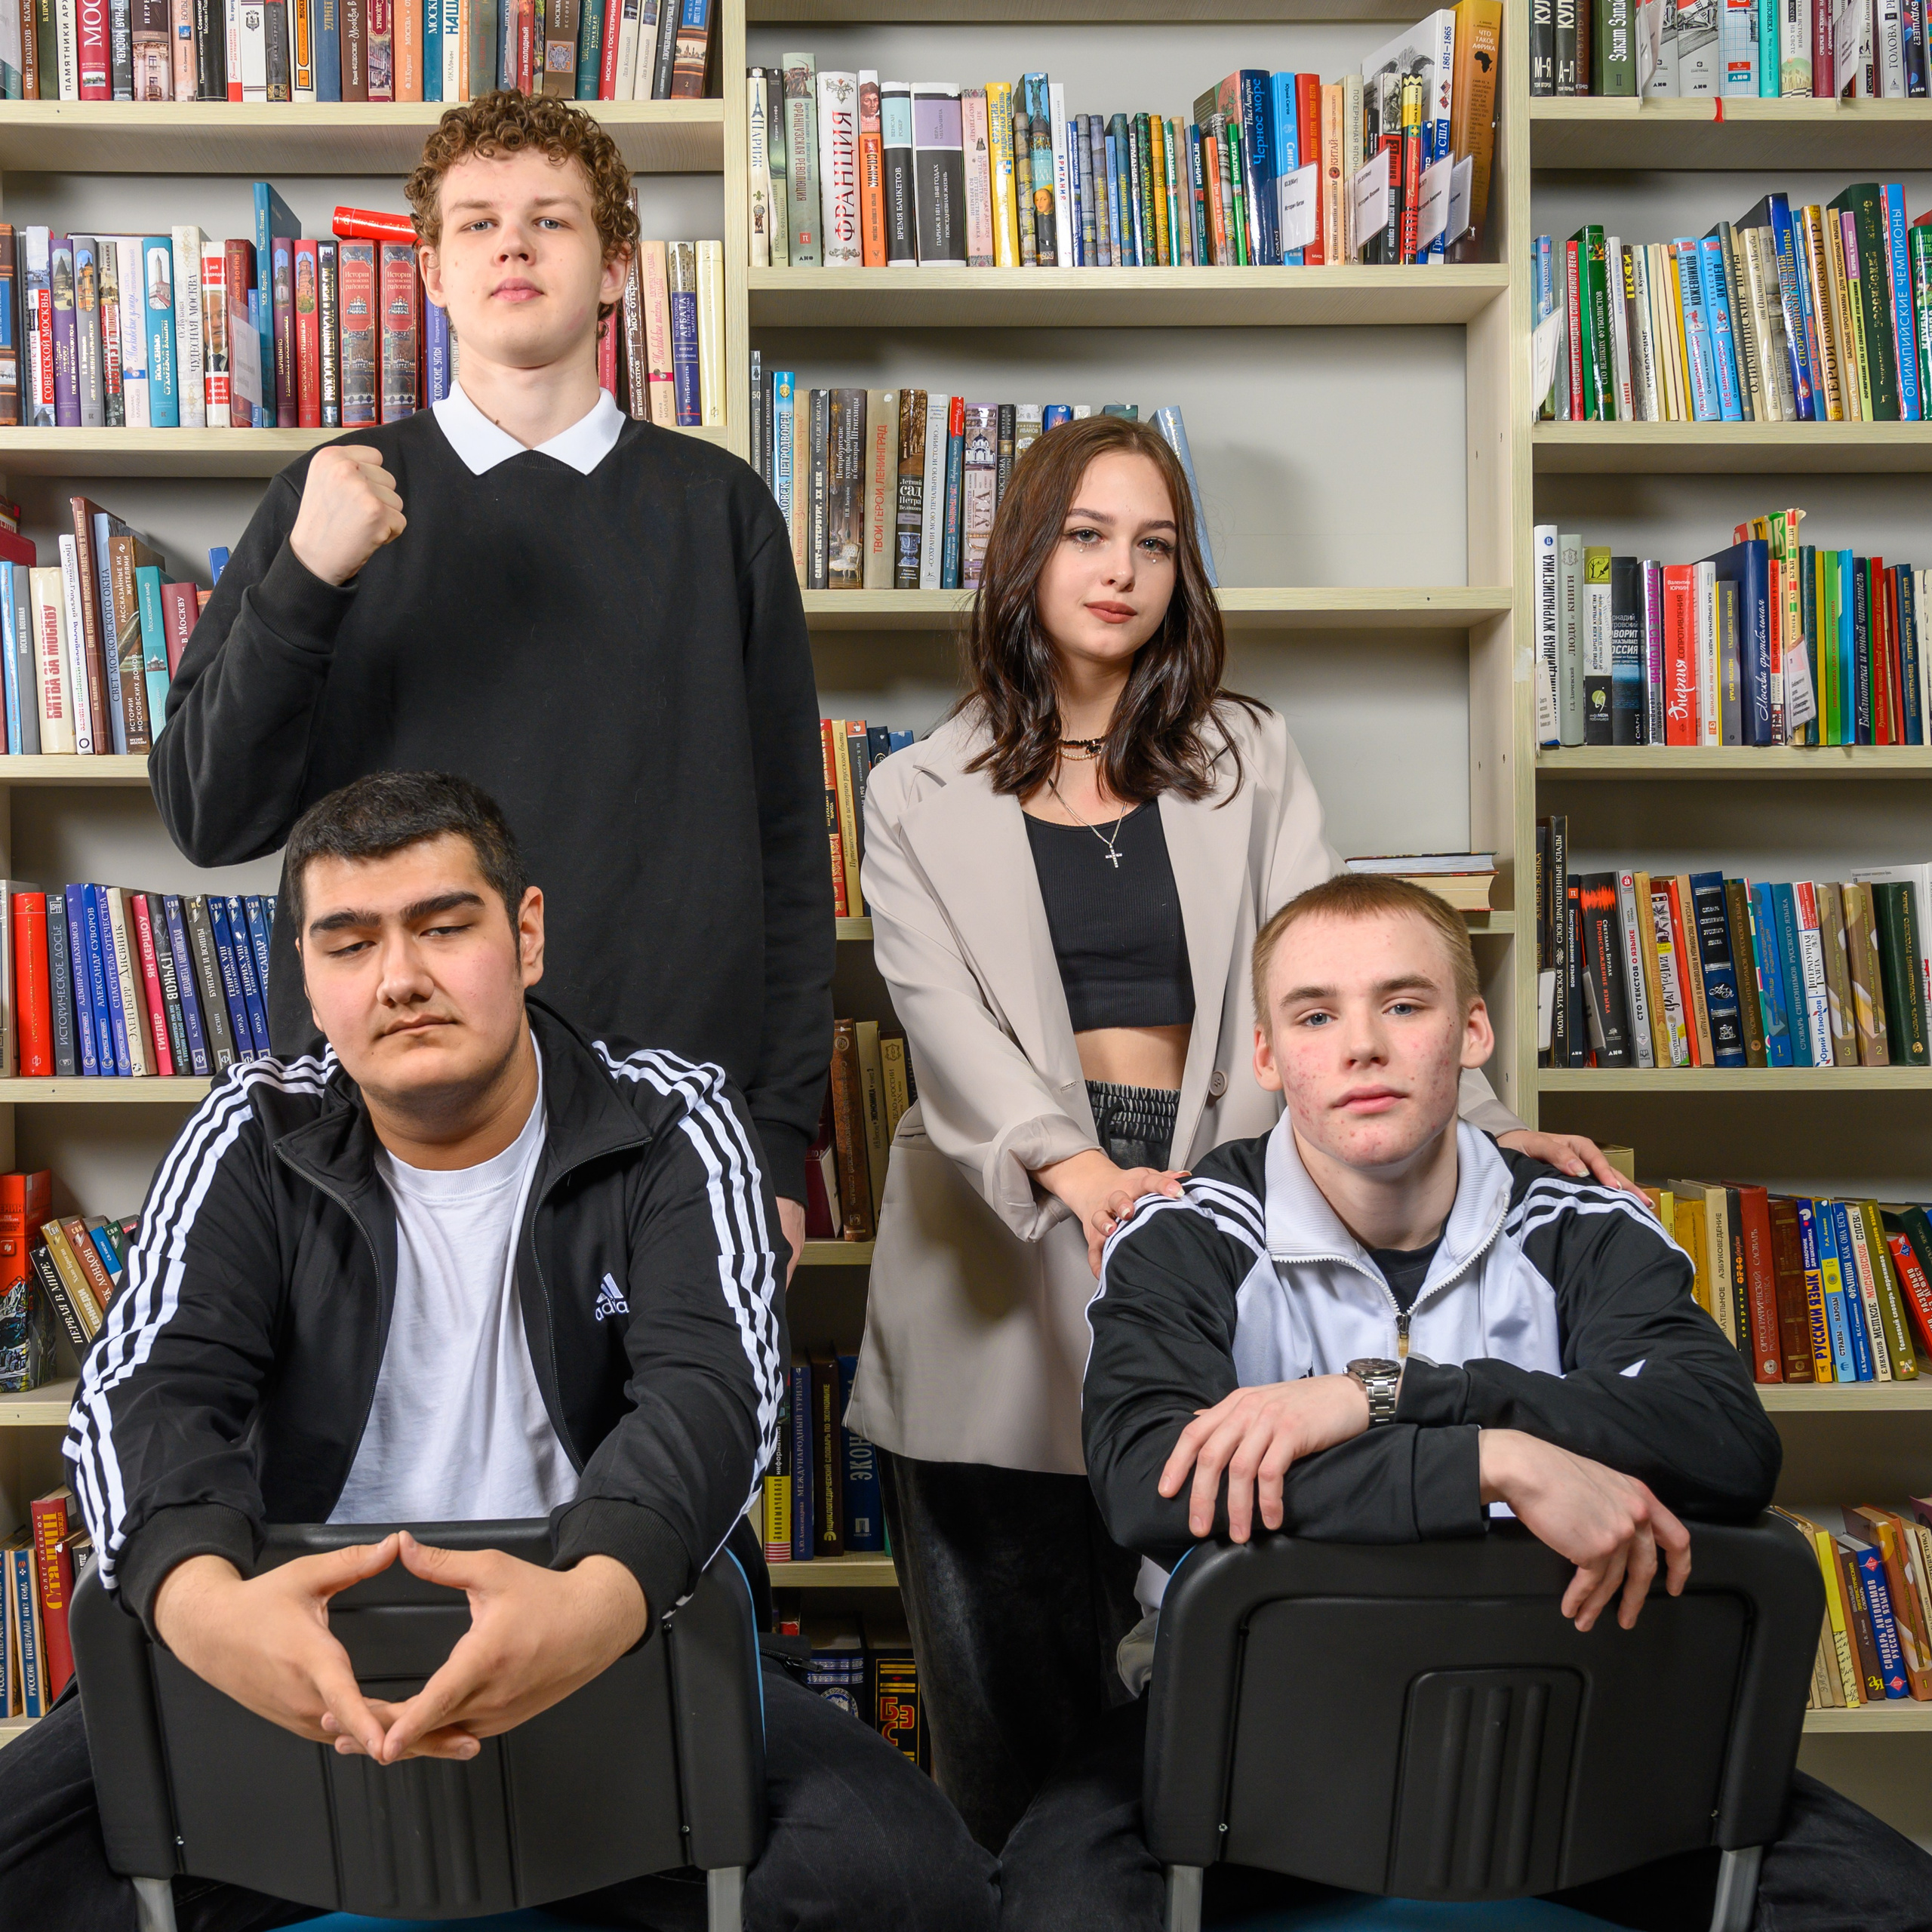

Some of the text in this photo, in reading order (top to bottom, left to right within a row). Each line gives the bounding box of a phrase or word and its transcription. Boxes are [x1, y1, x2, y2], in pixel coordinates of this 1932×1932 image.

[24, 29, 32, 64] ВОЛКОВ
[63, 23, 71, 91] ПАМЯТНИКИ
[1608, 29, 1627, 62] Закат
[1887, 23, 1897, 68] ГОЛОВА
[1252, 78, 1267, 165] Черное море
[1438, 122, 1447, 147] США
[793, 103, 806, 202] ФРАНЦУЗСКАЯ РЕВОЛЮЦИЯ
[1329, 137, 1338, 166] КИТАЙ:
[832, 110, 855, 242] ФРАНЦИЯ
[895, 168, 903, 211] БАНКЕТОВ
[1569, 269, 1578, 314] СПОРТИВНОГО
[1686, 255, 1702, 306] КОЖЕВНИКОВ
[1714, 264, 1725, 298] ЯКУШЕВ
[1893, 208, 1915, 397] ОЛИМПИЙСКИЕ ЧЕМПИОНЫ
[188, 274, 200, 372] ЧУДЕСНАЯ МОСКВА
[1571, 316, 1580, 352] СКАНДАЛЫ
[1596, 291, 1605, 338] ФУТБОЛИСТОВ
[40, 292, 52, 400] СОВЕТСКОЙ МОСКВЫ
[433, 347, 442, 365] УГЛЫ
[1598, 340, 1607, 369] ВЕЛИКИХ
[1573, 360, 1581, 394] СЕНСАЦИИ
[851, 398, 860, 439] Штиглицы
[780, 412, 792, 477] ПЕТРОДВОРЕЦ
[836, 426, 844, 478] Петербургские
[851, 441, 860, 473] банкиры
[876, 426, 887, 484] ЛЕНИНГРАД
[873, 524, 883, 554] ТВОИ
[116, 556, 127, 623] РАССКАЗАННЫЕ ИХ
[123, 555, 132, 595] ЖИТЕЛЯМИ
[1543, 554, 1555, 631] ЖУРНАЛИСТИКА
[1856, 573, 1865, 623] читатель
[102, 568, 120, 702] СВЕТ МОСКОВСКОГО ОКНА
[146, 597, 154, 632] Московский
[1648, 569, 1660, 683] БУДУЩЕЕ СЕГОДНЯ
[41, 605, 63, 719] БИТВА ЗА МОСКВУ
[1755, 599, 1770, 721] Москва футбольная
[1857, 625, 1866, 654] юный
[134, 682, 143, 731] МОСКОВСКИХ
[1668, 660, 1695, 720] Энергия
[1859, 665, 1869, 728] Библиотека
[128, 698, 136, 731] ИСТОРИИ
[839, 753, 849, 781] русского
[845, 820, 856, 868] Путешествие
[88, 907, 99, 950] СУВОРОВ
[100, 897, 112, 951] ОТЕЧЕСТВА
[139, 915, 155, 978] ЯН КЕРШОУ
[197, 928, 208, 955] ВОИНЫ
[1629, 929, 1637, 956] ЯЗЫКЕ
[53, 924, 69, 1045] ИСТОРИЧЕСКОЕ ДОСЬЕ
[72, 921, 85, 1005] АДМИРАЛ НАХИМОВ
[93, 953, 105, 1007] АЛЕКСАНДР
[108, 953, 121, 1008] СПАСИТЕЛЬ
[161, 958, 178, 999] ГУЧКОВ
[204, 964, 217, 997] БУНТАРИ
[223, 964, 235, 997] ГЕНРИХ
[1632, 965, 1642, 1002] ТЕКСТОВ
[1783, 899, 1807, 1050] СЛОВАРЬ СИНОНИМОВ РУССКОГО ЯЗЫКА
[154, 1013, 166, 1051] ГИТЛЕР
[869, 1089, 878, 1121] ЭКОНОМИКА
[83, 1247, 107, 1286] ЛОНДОН
[1716, 1214, 1724, 1278] АЗБУКОВЕДЕНИЕ
[41, 1262, 60, 1291] МИРЕ
[1844, 1262, 1857, 1299] ФРАНЦИЯ
[1859, 1244, 1875, 1299] МОСКОВСКОЕ
[1868, 1206, 1906, 1351] Толковый словарь паронимов русского языка
[56, 1303, 83, 1343] ПЕРВАЯ
[1806, 1273, 1827, 1359] РУССКИЙ ЯЗЫК
[824, 1423, 830, 1432] ПО
[795, 1414, 804, 1496] МЕЖДУНАРОДНЫЙ
[37, 1515, 45, 1561] ХЛЕВНЮК
[23, 1620, 33, 1660] ГЕНЕРАЛЫ
[1867, 1580, 1894, 1669] СЛОВАРЬ АНТОНИМОВ
[1878, 1586, 1900, 1659] РУССКОГО ЯЗЫКА
[26, 1662, 36, 1697] РУССКИЕ
